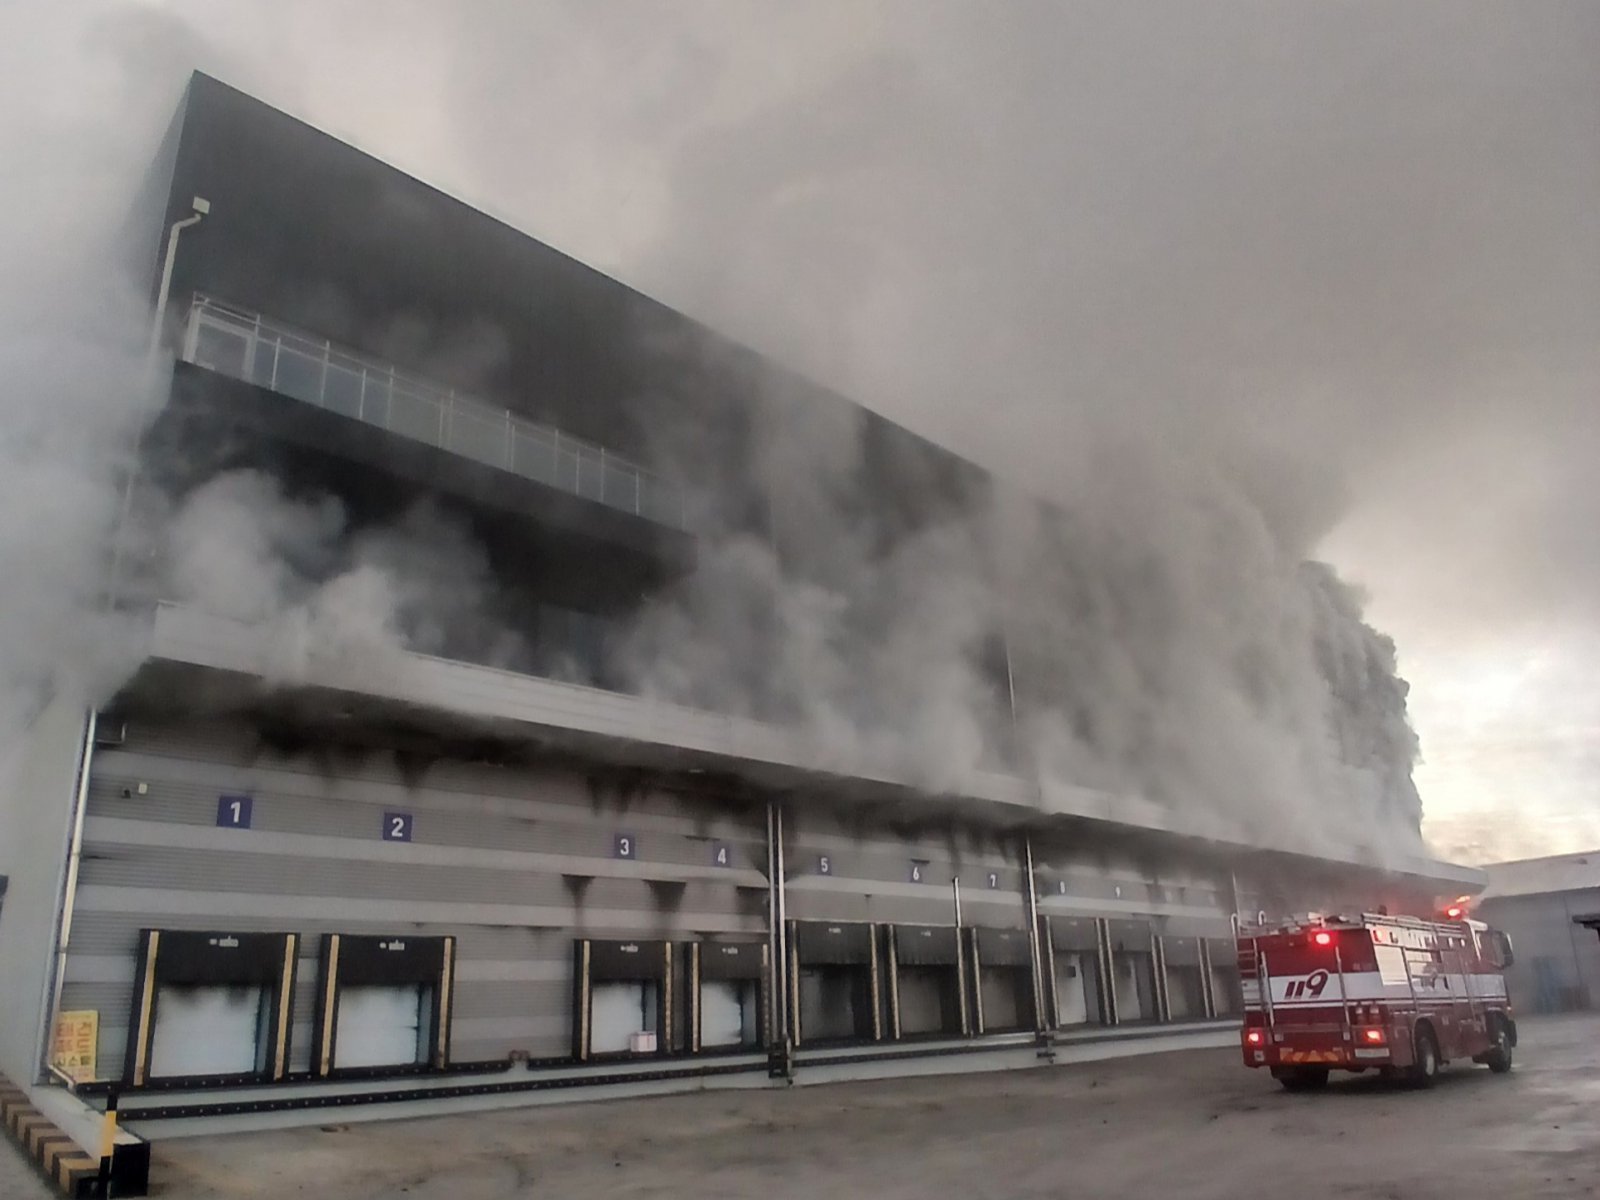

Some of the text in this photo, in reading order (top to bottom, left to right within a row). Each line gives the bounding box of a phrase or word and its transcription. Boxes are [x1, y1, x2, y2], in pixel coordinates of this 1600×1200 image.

[230, 801, 241, 823] 1
[391, 817, 405, 838] 2
[619, 838, 630, 856] 3
[717, 848, 727, 864] 4
[820, 857, 829, 872] 5
[912, 866, 920, 880] 6
[989, 874, 997, 887] 7
[1284, 968, 1330, 1000] 119
